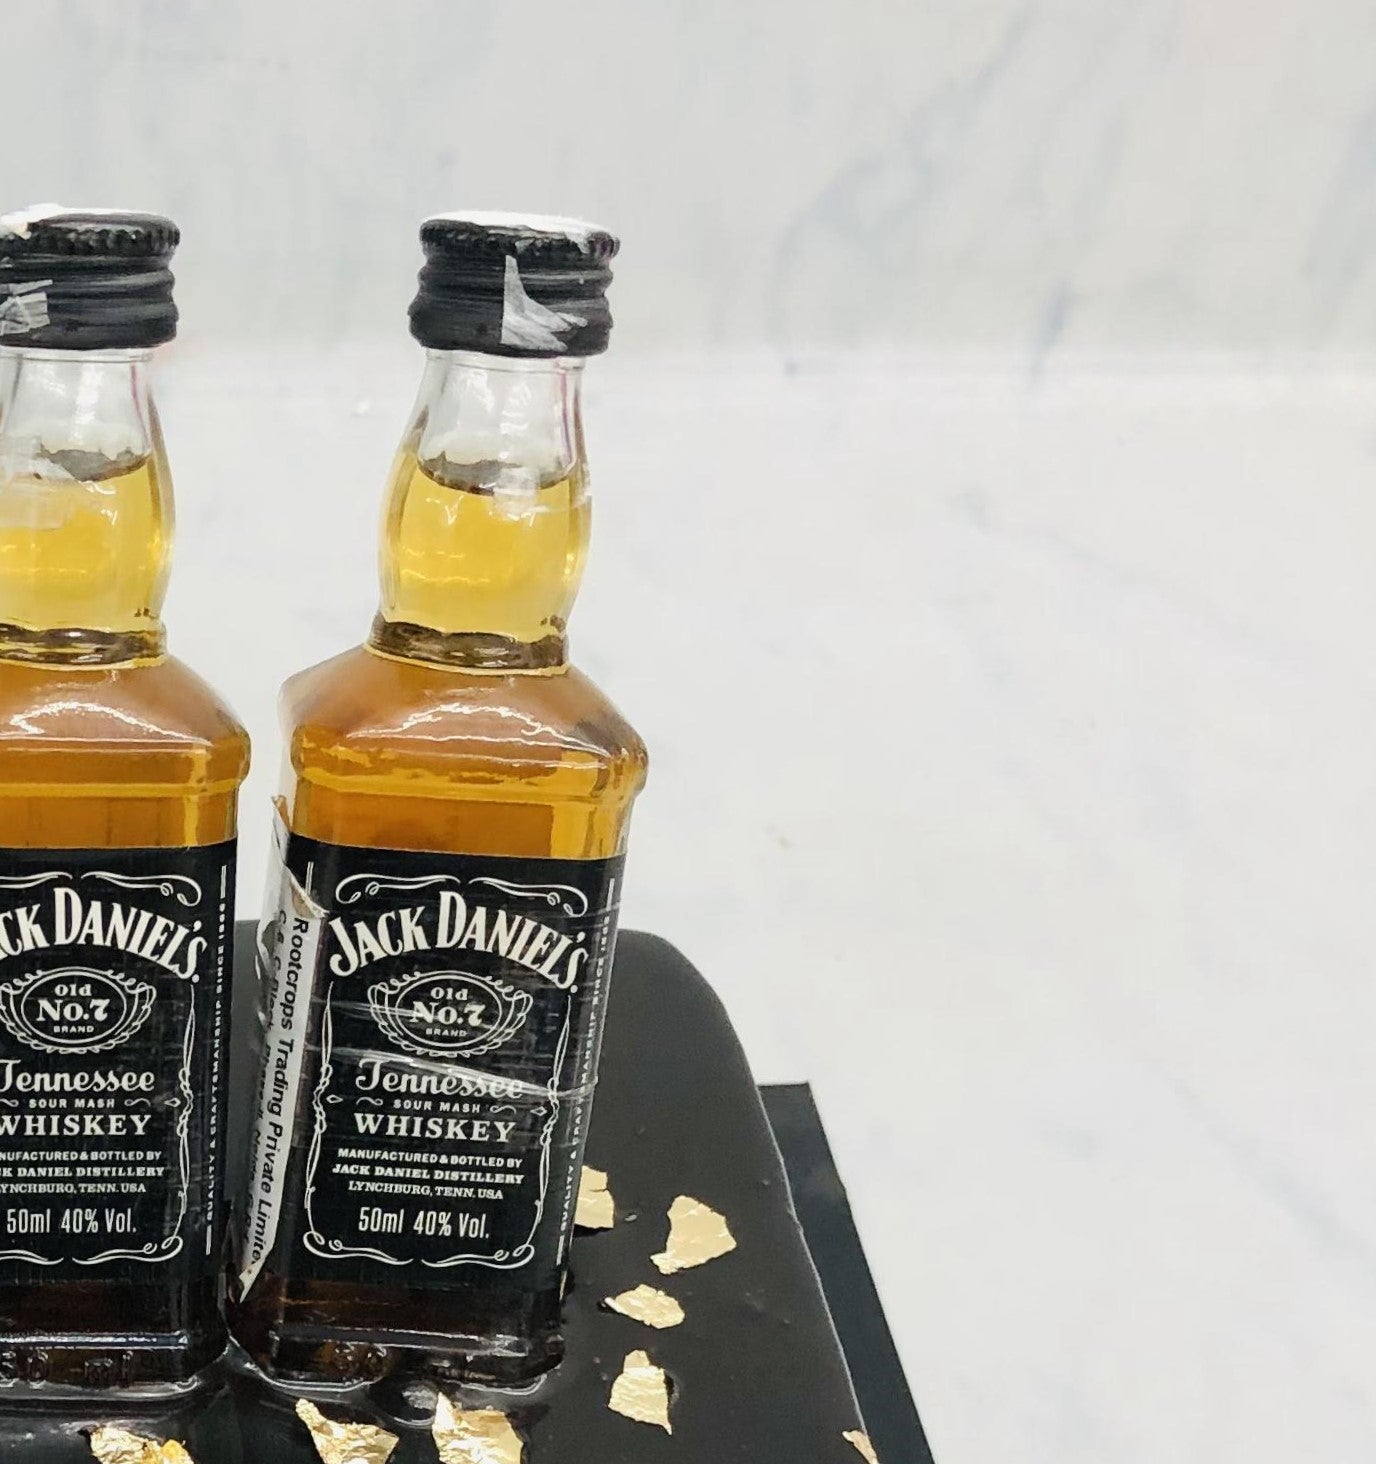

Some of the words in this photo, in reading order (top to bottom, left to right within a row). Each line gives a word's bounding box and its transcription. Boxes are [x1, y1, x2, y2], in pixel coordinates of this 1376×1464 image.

[329, 905, 431, 977] JACK
[280, 917, 309, 1031] Rootcrops
[53, 983, 92, 997] Old
[430, 986, 468, 1001] Old
[53, 1025, 95, 1033] BRAND
[426, 1028, 468, 1037] BRAND
[267, 1038, 295, 1117] Trading
[355, 1058, 525, 1099] Tennessee
[28, 1098, 68, 1108] SOUR
[74, 1098, 115, 1108] MASH
[393, 1099, 432, 1110] SOUR
[439, 1102, 481, 1113] MASH
[354, 1112, 517, 1143] WHISKEY
[90, 1151, 144, 1161] BOTTLED
[146, 1151, 162, 1161] BY
[260, 1121, 283, 1194] Private
[338, 1148, 438, 1164] MANUFACTURED
[450, 1155, 505, 1167] BOTTLED
[506, 1158, 523, 1168] BY
[17, 1166, 73, 1177] DANIEL
[75, 1166, 165, 1177] DISTILLERY
[332, 1164, 370, 1175] JACK
[374, 1166, 430, 1179] DANIEL
[433, 1169, 525, 1185] DISTILLERY
[120, 1183, 146, 1193] USA
[477, 1188, 504, 1200] USA
[6, 1208, 51, 1234] 50ml
[61, 1208, 99, 1234] 40%
[104, 1208, 137, 1234] Vol.
[358, 1206, 404, 1234] 50ml
[413, 1210, 452, 1237] 40%
[458, 1212, 490, 1239] Vol.
